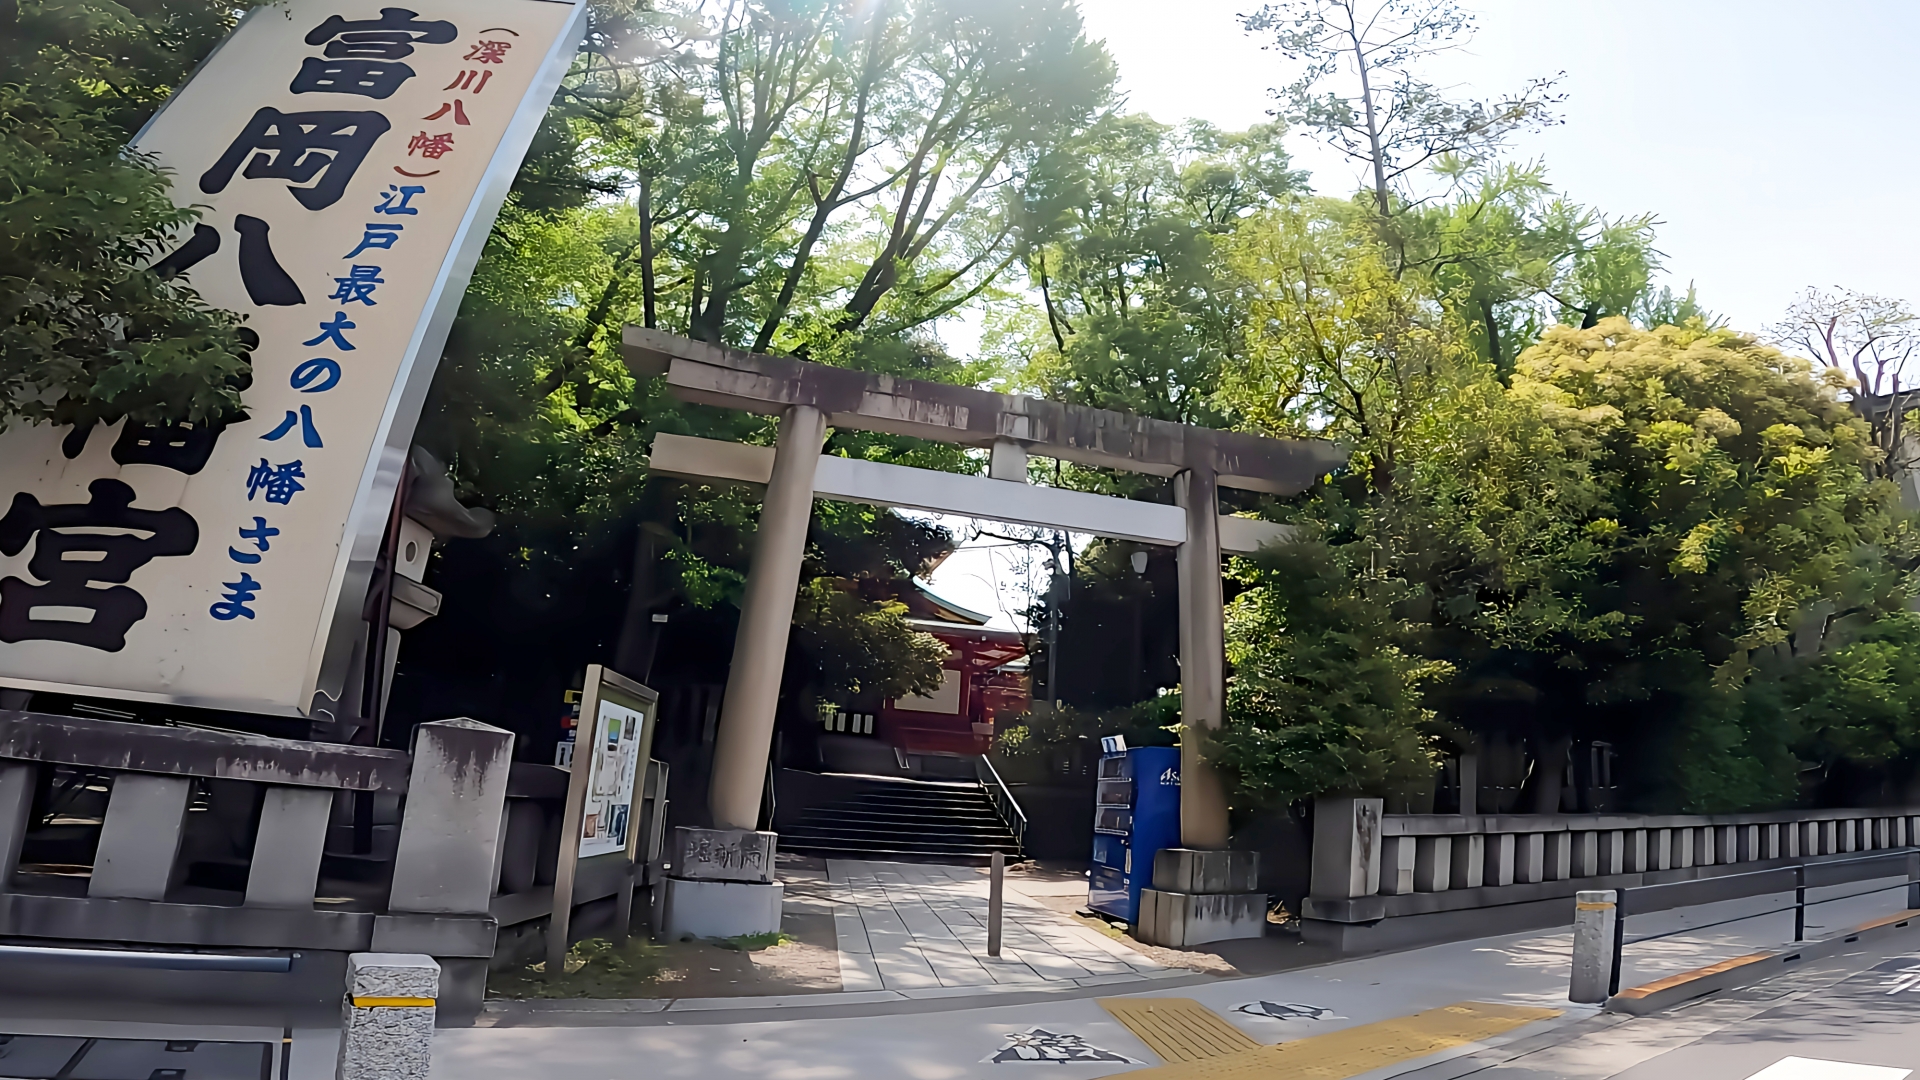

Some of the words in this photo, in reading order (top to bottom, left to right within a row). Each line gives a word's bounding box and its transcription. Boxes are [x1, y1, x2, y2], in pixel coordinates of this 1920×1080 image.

[209, 184, 426, 622] 江戸最大の八幡さま
